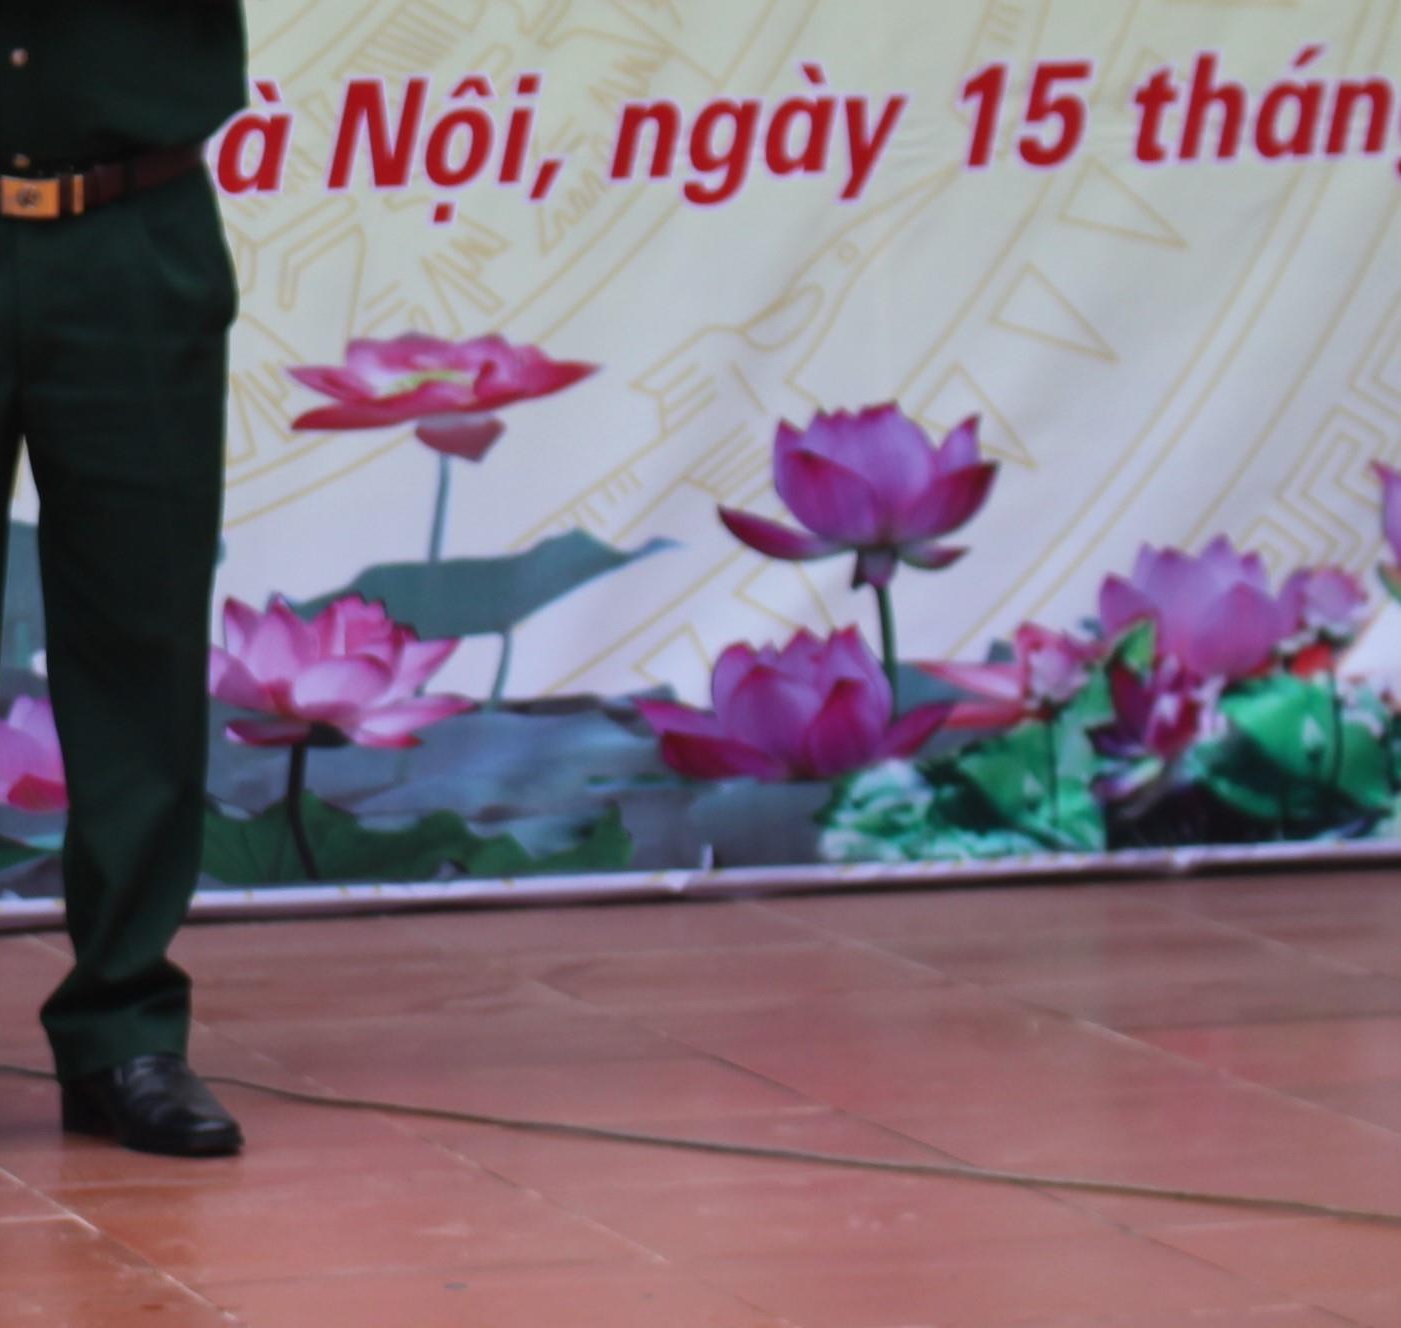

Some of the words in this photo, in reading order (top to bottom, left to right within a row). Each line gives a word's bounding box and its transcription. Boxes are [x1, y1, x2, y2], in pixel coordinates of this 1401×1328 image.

[214, 80, 292, 196] à
[325, 73, 561, 225] Nội,
[609, 63, 906, 208] ngày
[961, 60, 1092, 169] 15
[1133, 46, 1401, 174] thán
